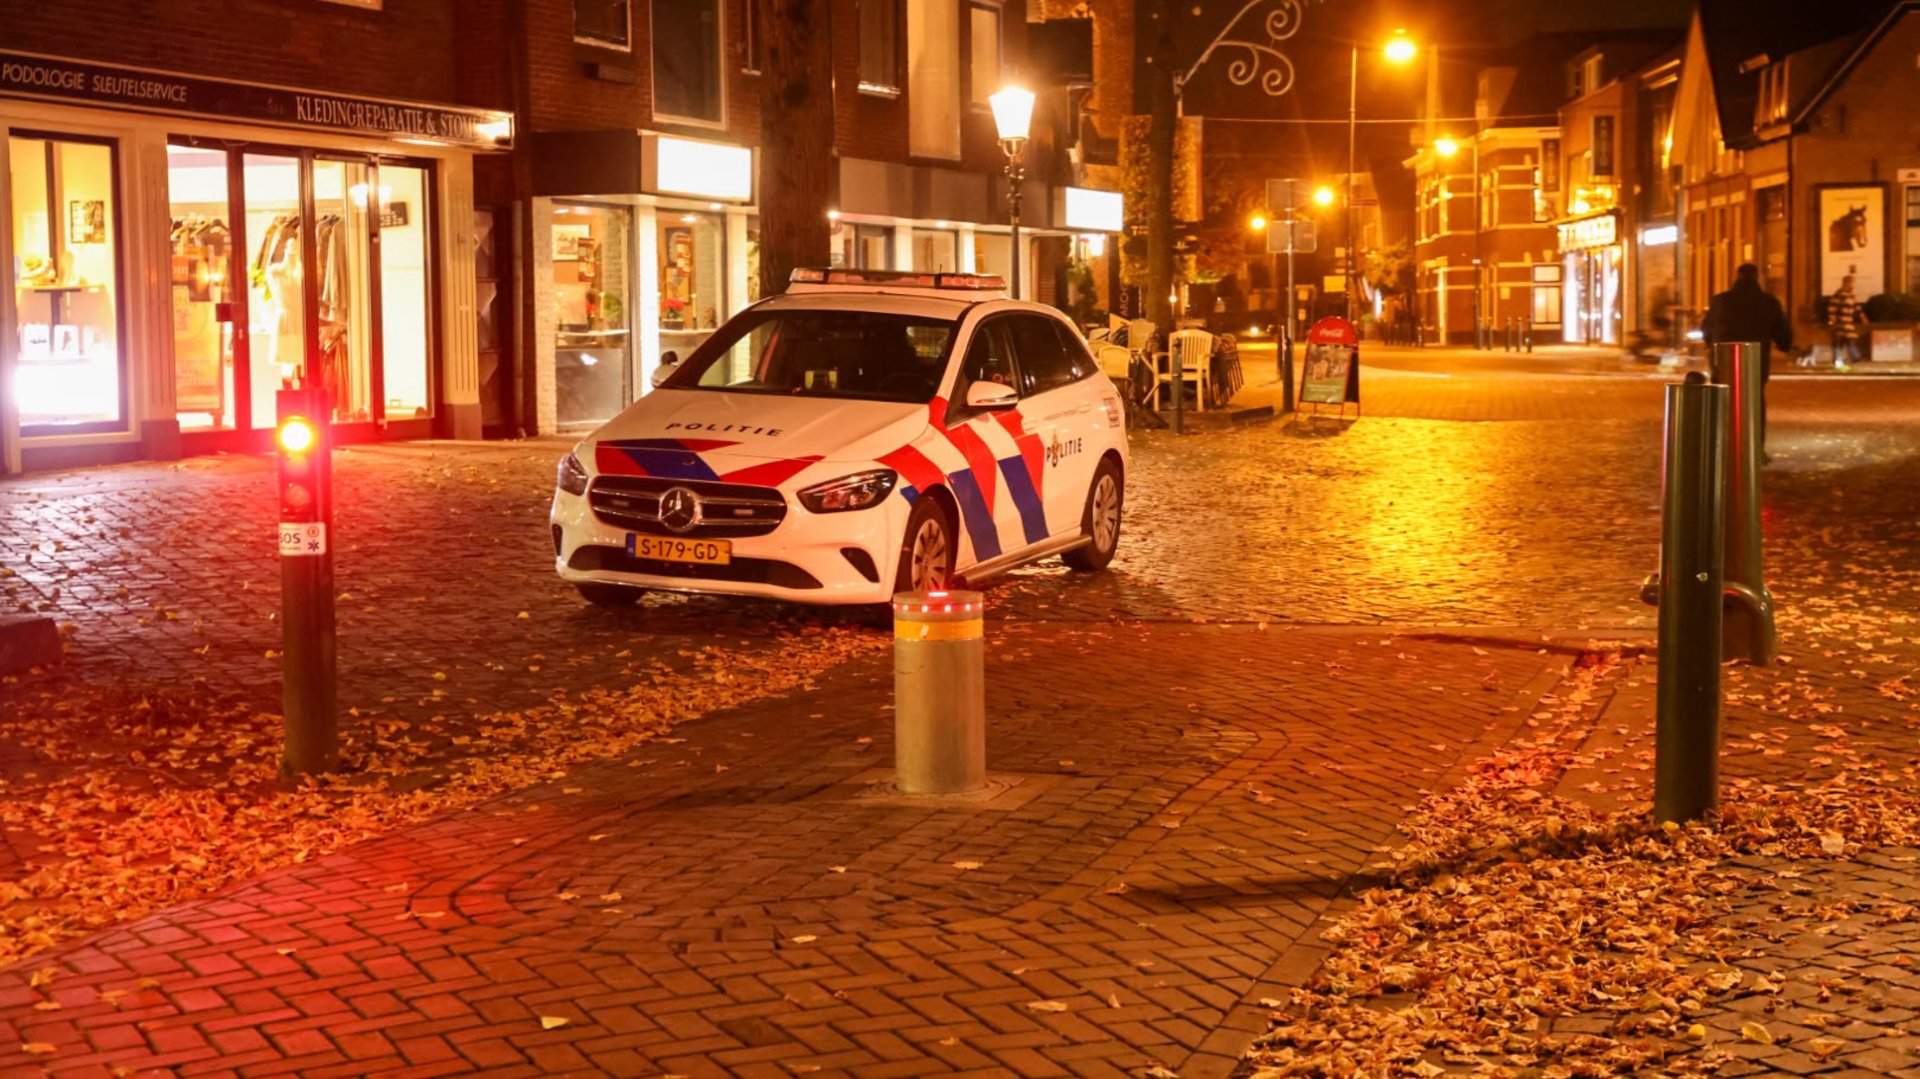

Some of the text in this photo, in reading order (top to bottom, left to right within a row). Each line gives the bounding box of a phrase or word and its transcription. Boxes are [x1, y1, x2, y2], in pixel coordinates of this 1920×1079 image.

[2, 63, 188, 102] PODOLOGIE SLEUTELSERVICE
[296, 96, 424, 134] KLEDINGREPARATIE
[426, 115, 436, 134] &
[665, 423, 783, 436] POLITIE
[641, 538, 719, 560] S-179-GD
